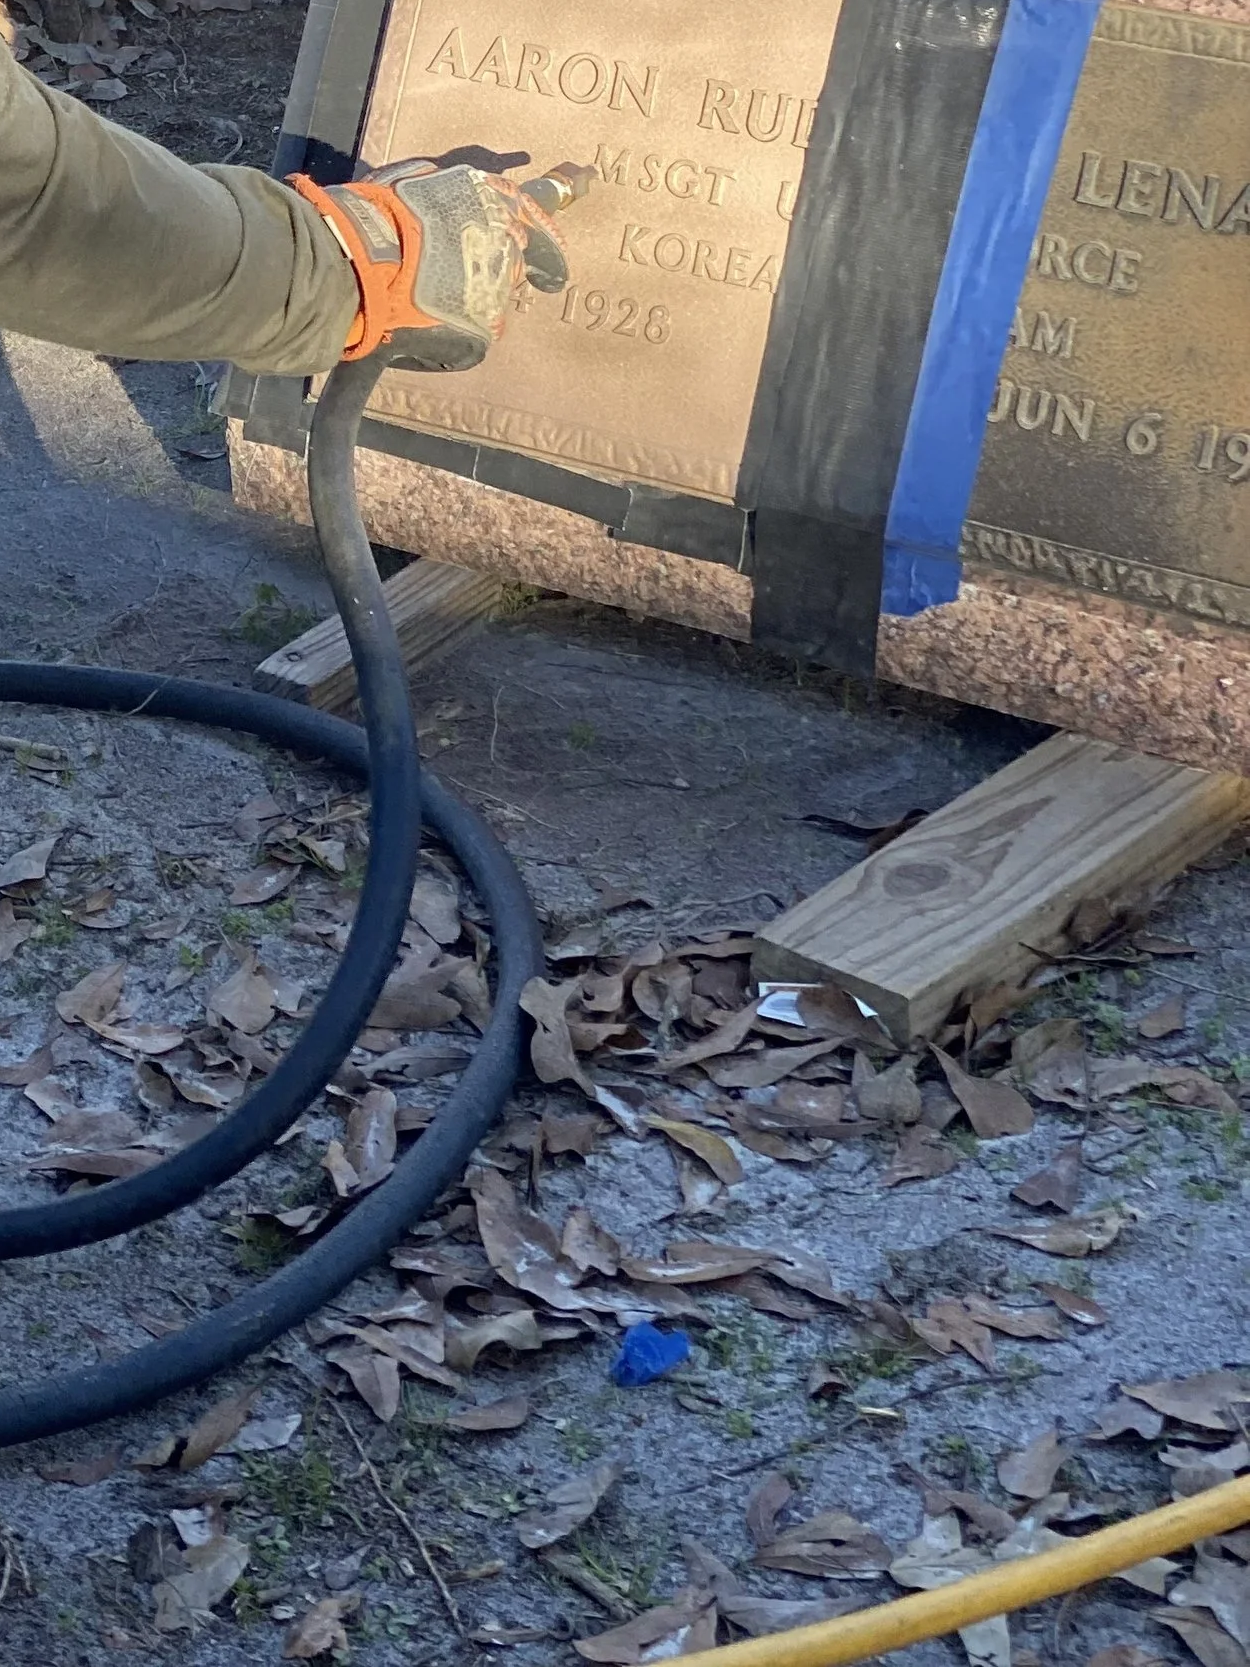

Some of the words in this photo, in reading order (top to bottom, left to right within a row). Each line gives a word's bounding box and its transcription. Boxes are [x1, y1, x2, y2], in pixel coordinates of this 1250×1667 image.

[426, 26, 660, 118] AARON
[593, 143, 738, 208] MSGT
[1031, 234, 1142, 292] RCE
[619, 224, 781, 295] KOREA
[560, 284, 672, 345] 1928
[986, 377, 1096, 443] JUN
[1125, 412, 1163, 456] 6
